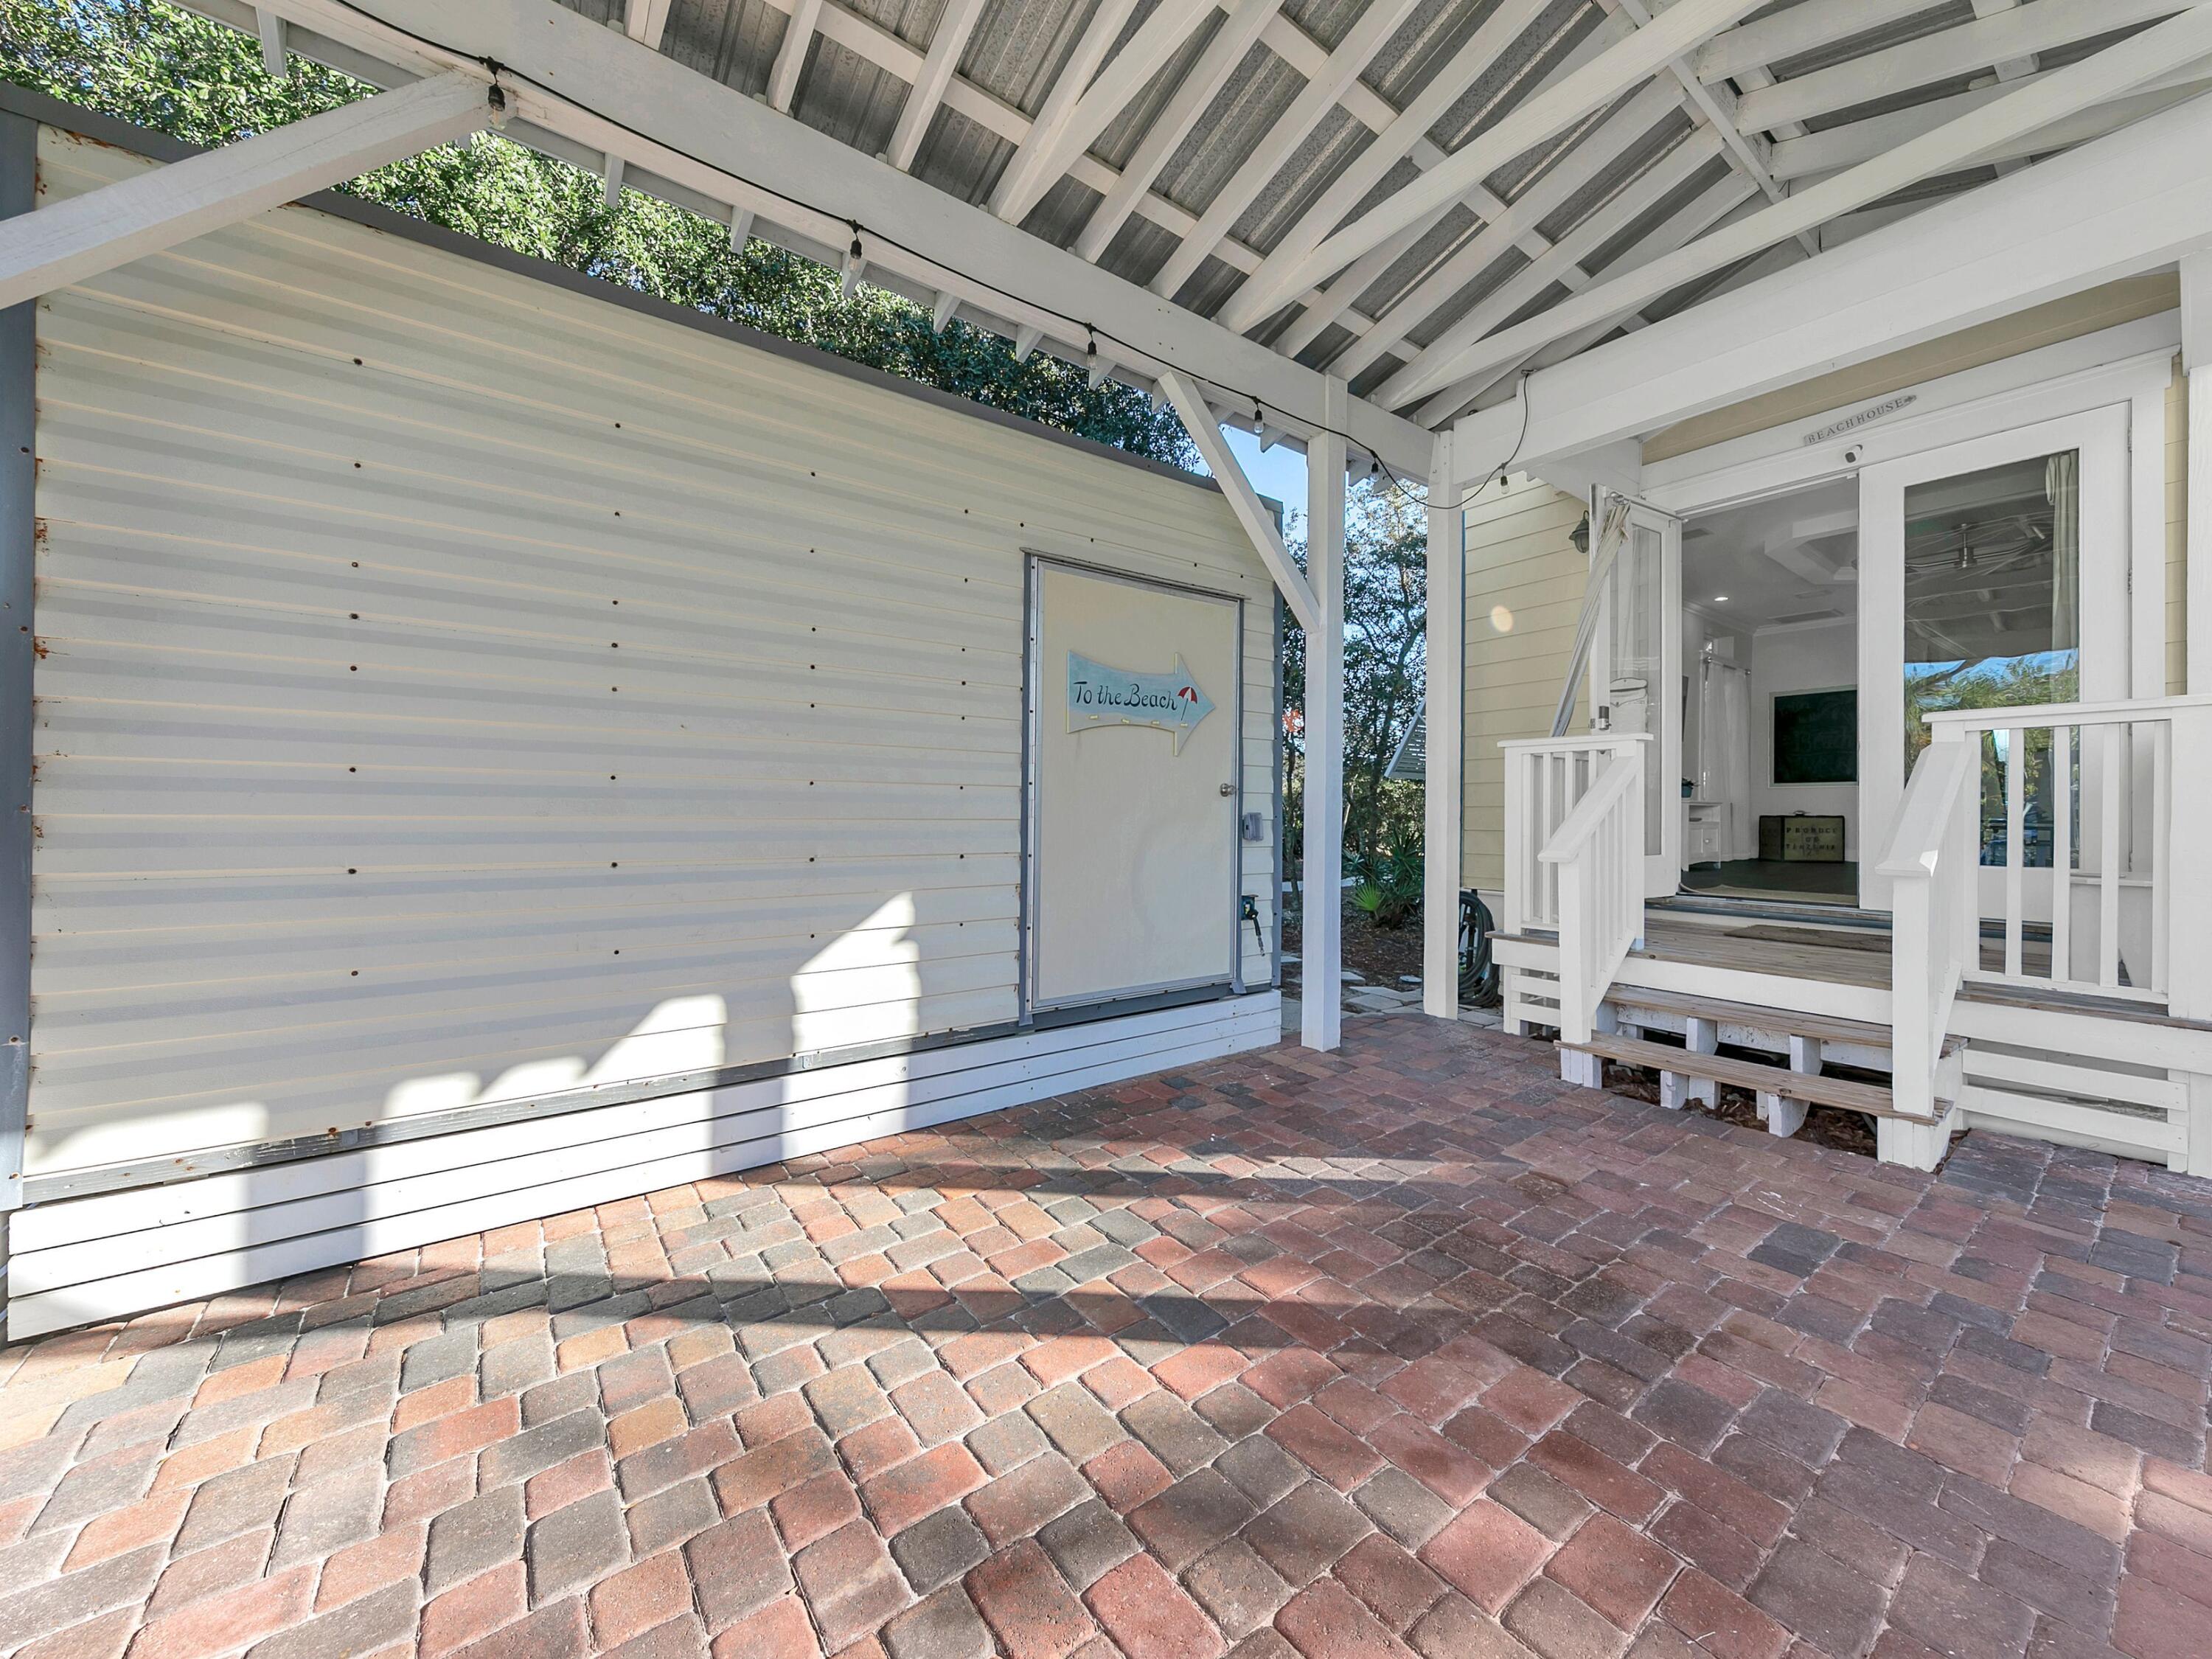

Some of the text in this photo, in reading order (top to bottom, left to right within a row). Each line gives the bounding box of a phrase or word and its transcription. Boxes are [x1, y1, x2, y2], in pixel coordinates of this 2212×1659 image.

[1808, 398, 1905, 444] BEACH HOUSE
[1074, 681, 1178, 711] To the Beach
